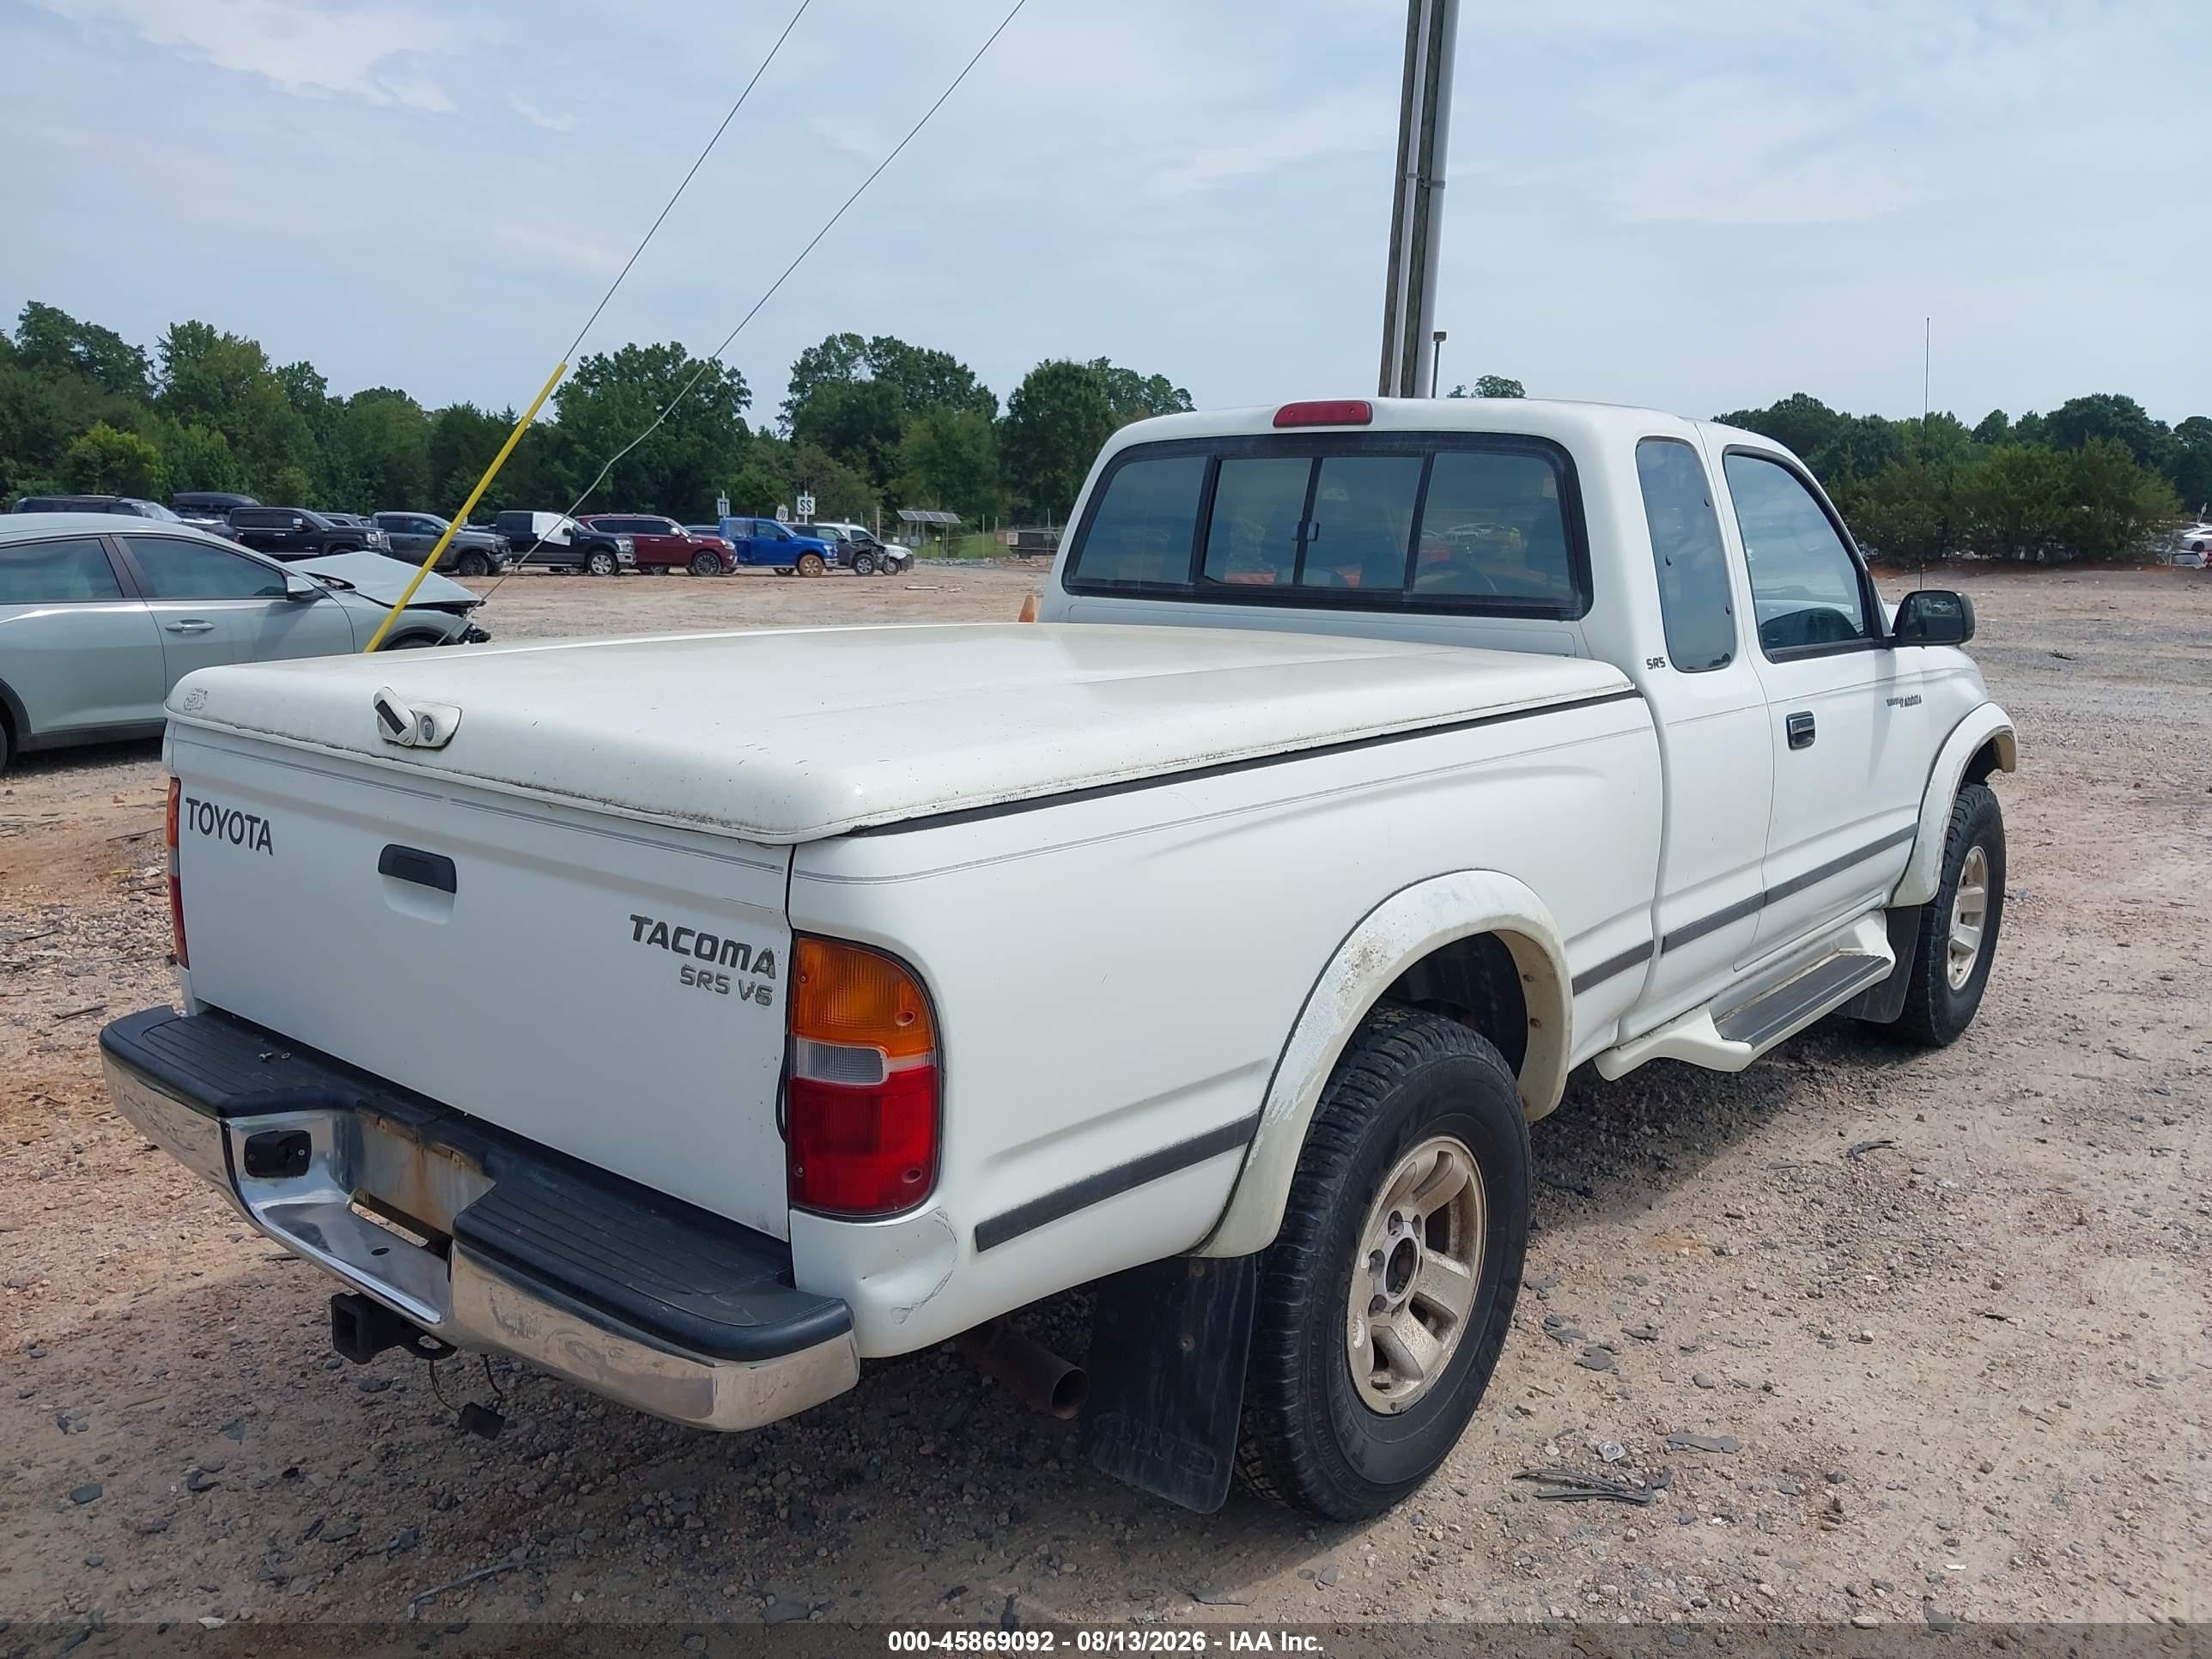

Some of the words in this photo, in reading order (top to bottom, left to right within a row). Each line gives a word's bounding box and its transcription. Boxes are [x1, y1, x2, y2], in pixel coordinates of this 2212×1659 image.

[799, 500, 812, 513] SS
[1646, 657, 1666, 670] SR5
[185, 797, 274, 856] TOYOTA
[630, 914, 776, 980] TACOMA
[679, 963, 731, 995] SR5
[738, 979, 774, 1006] V6
